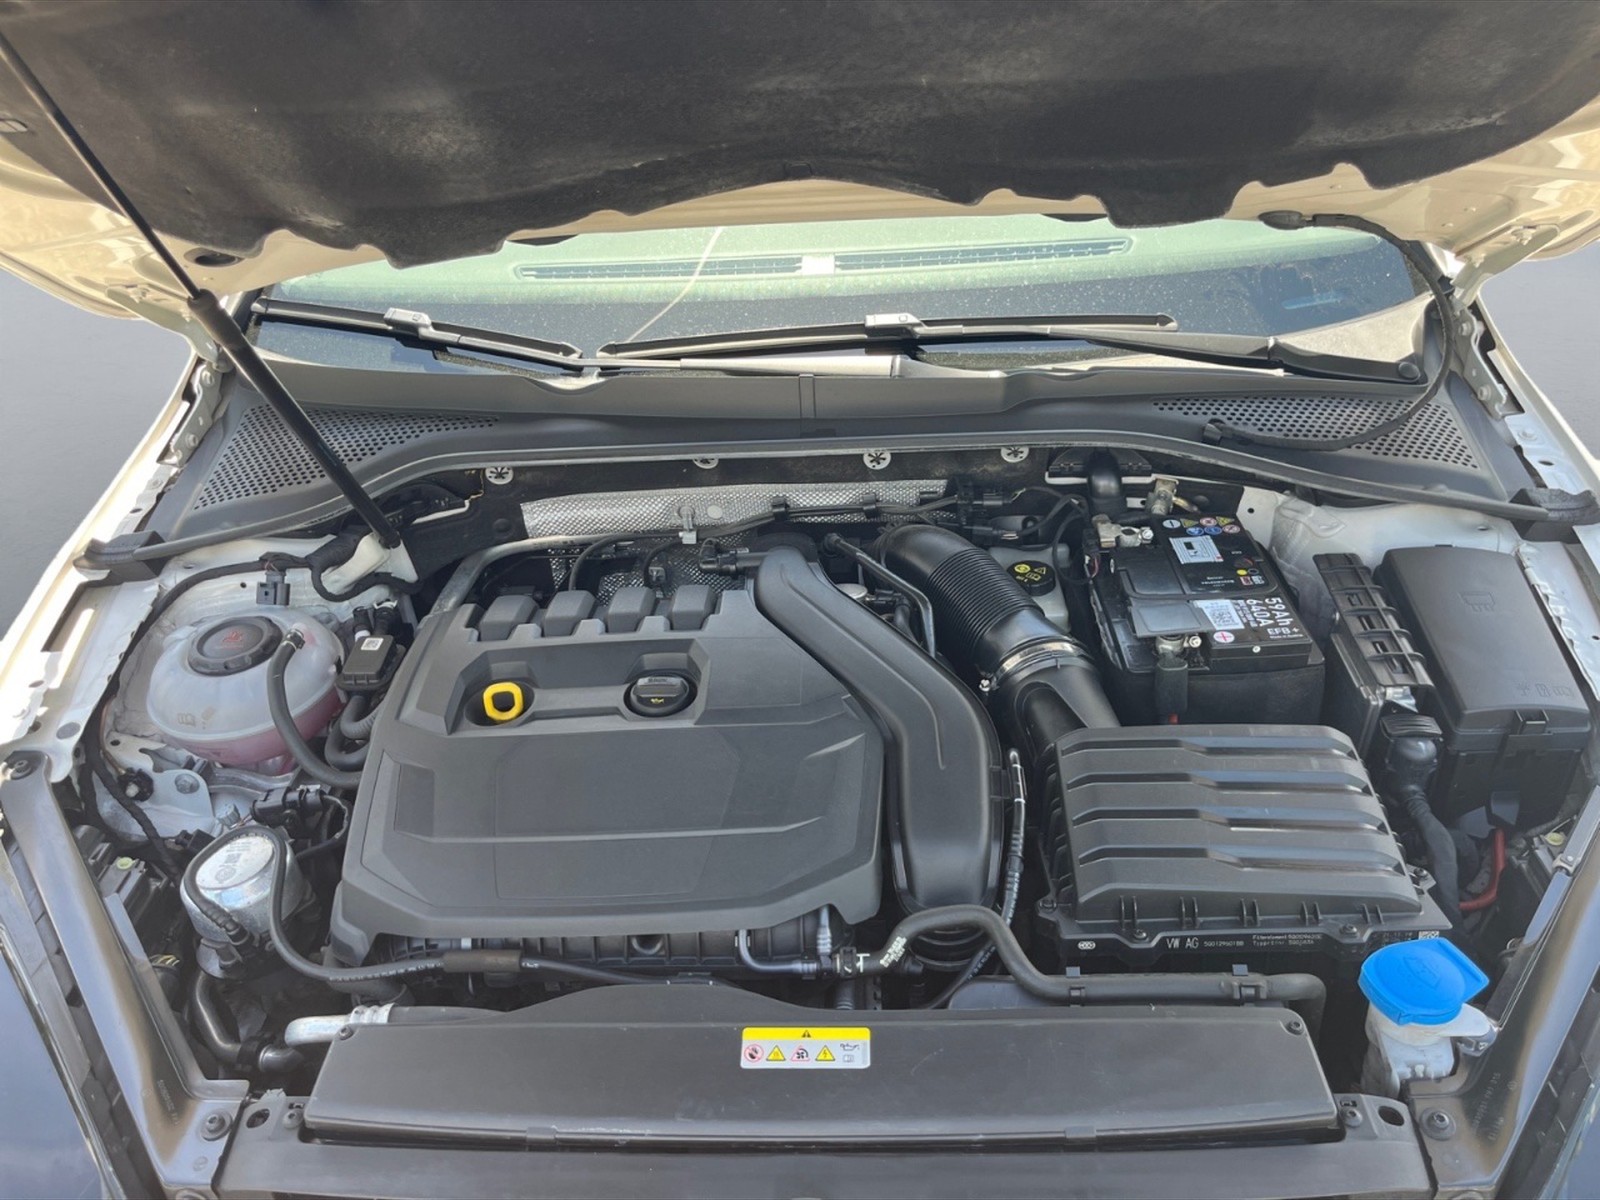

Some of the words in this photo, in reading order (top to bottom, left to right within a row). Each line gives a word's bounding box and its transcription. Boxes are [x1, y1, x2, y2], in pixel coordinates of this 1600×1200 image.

[1246, 598, 1275, 627] 640A
[1265, 597, 1294, 626] 59Ah
[1166, 937, 1181, 949] VW
[1185, 936, 1199, 949] AG
